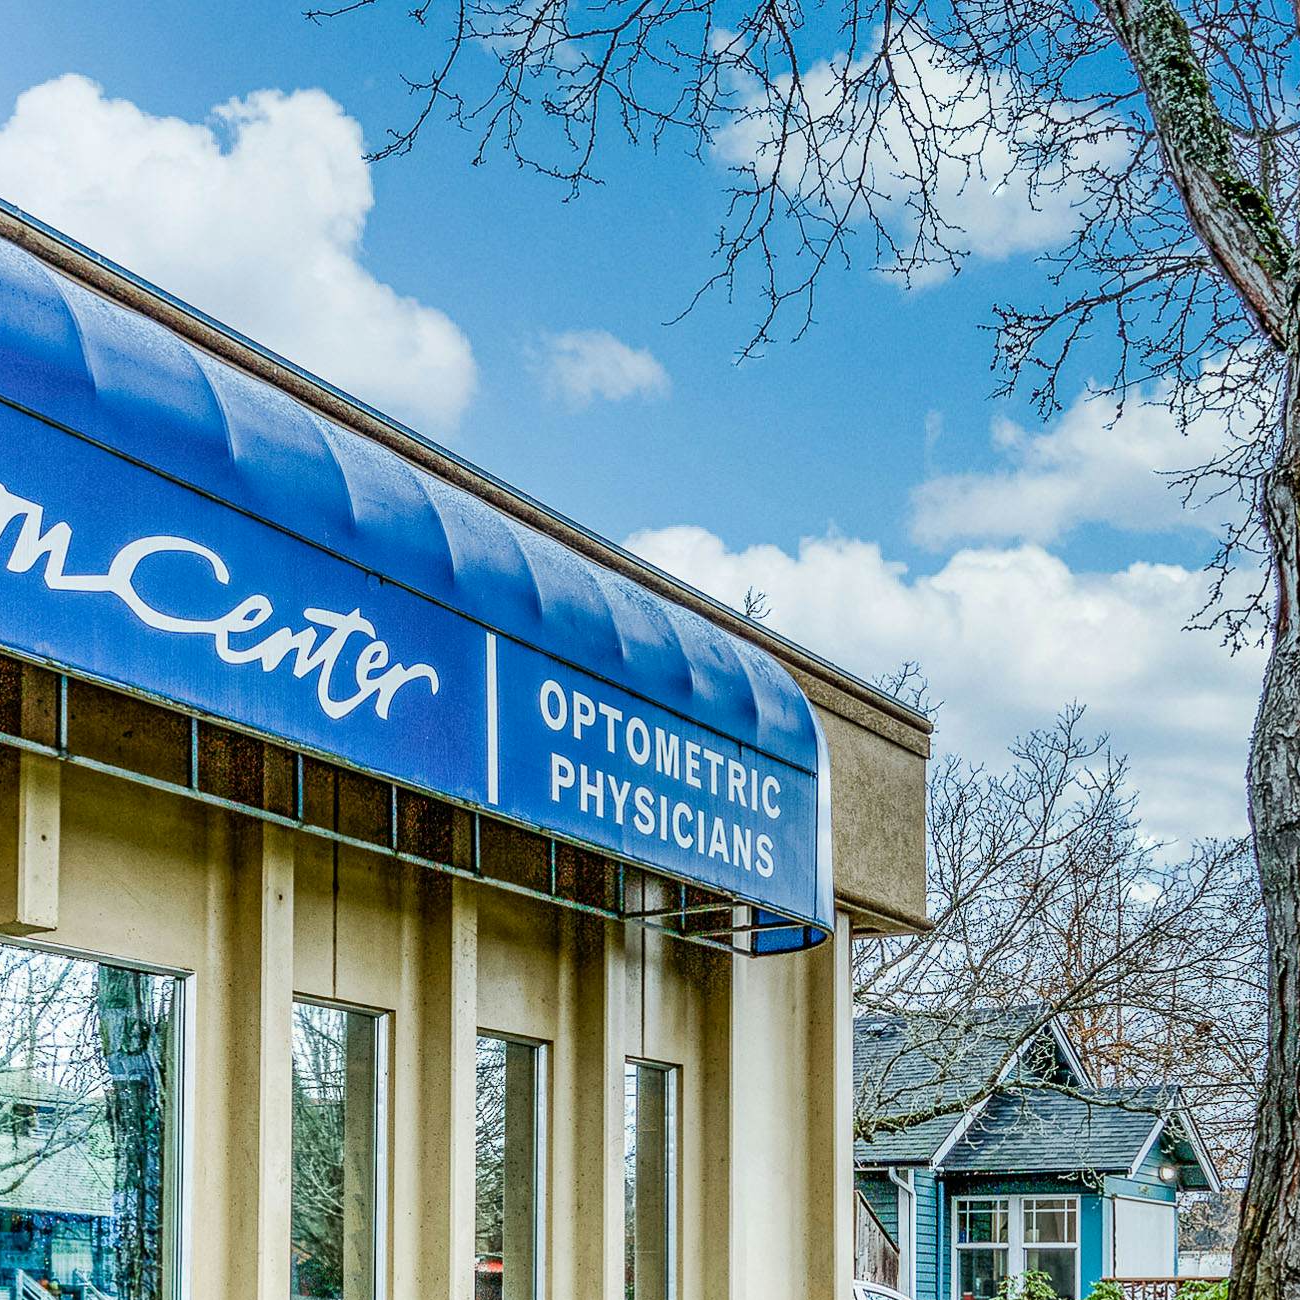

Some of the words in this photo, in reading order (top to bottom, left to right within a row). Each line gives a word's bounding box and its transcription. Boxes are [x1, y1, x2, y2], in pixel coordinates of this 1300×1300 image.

[111, 535, 439, 720] Center
[540, 679, 782, 820] OPTOMETRIC
[551, 752, 775, 878] PHYSICIANS
